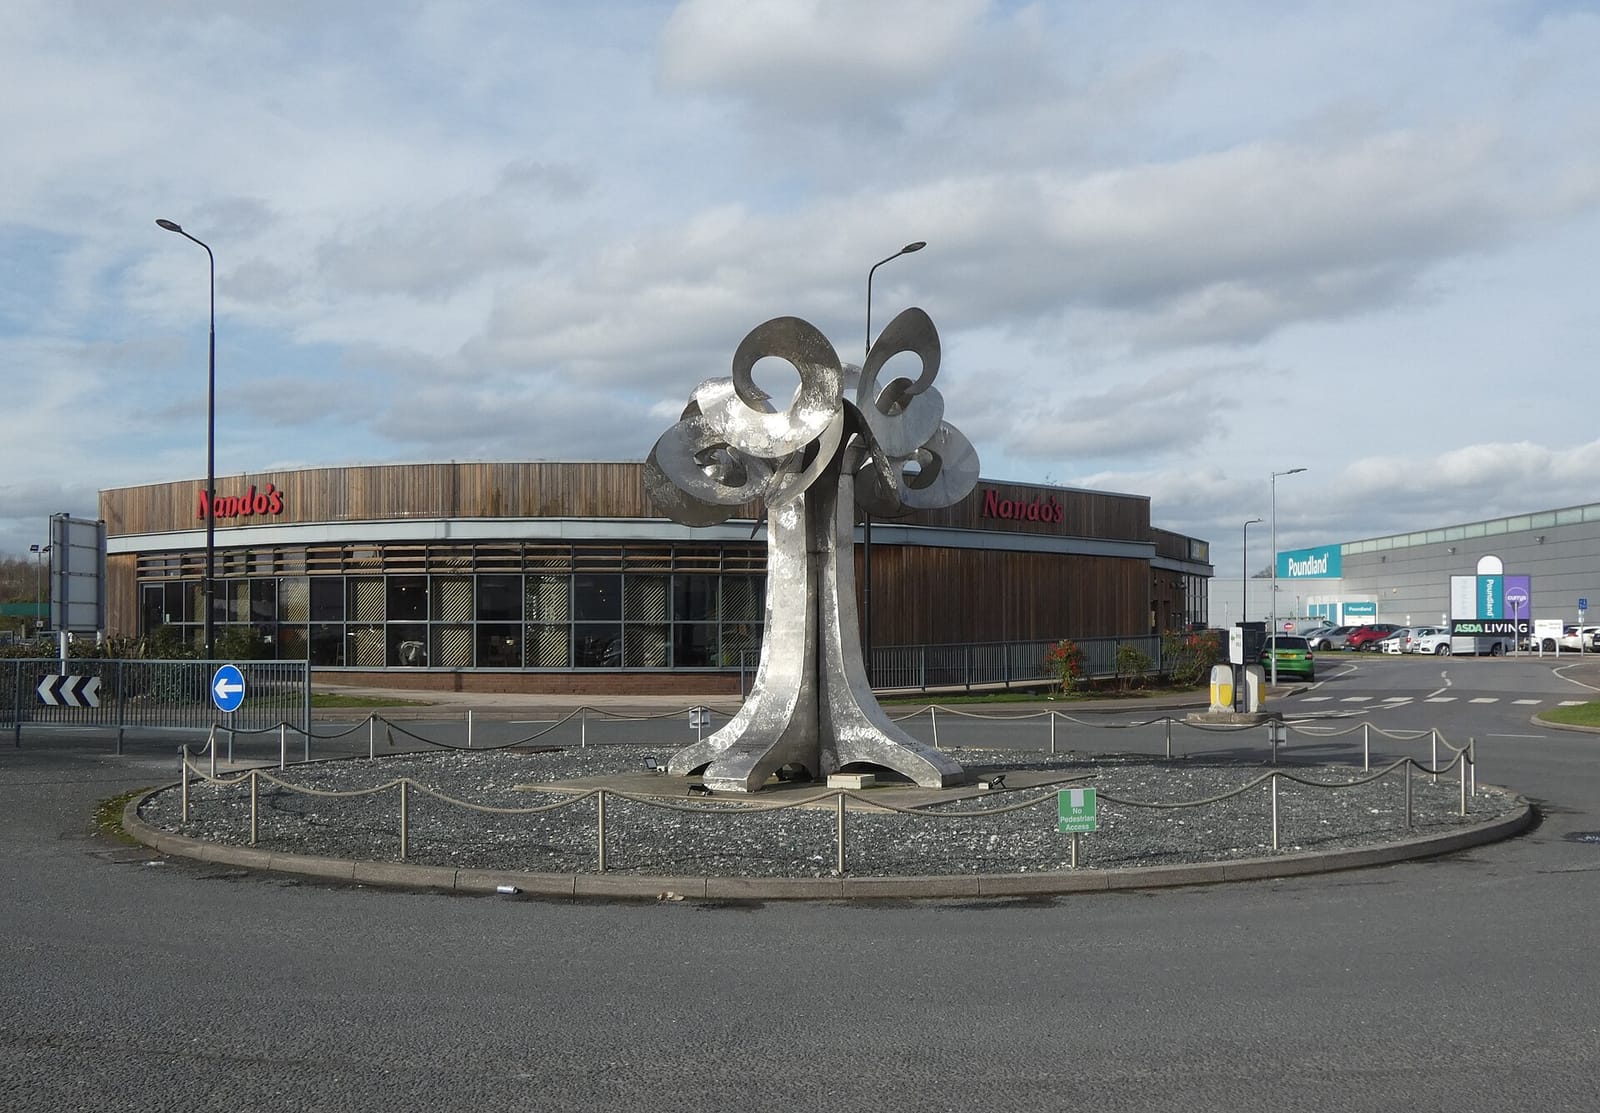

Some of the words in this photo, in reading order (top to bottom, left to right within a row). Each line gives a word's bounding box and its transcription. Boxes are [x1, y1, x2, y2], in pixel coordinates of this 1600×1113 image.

[196, 482, 283, 519] Nando's
[982, 487, 1064, 523] Nando's
[1288, 553, 1328, 576] Poundland
[1486, 579, 1494, 617] Poundland
[1454, 624, 1482, 633] ASDA
